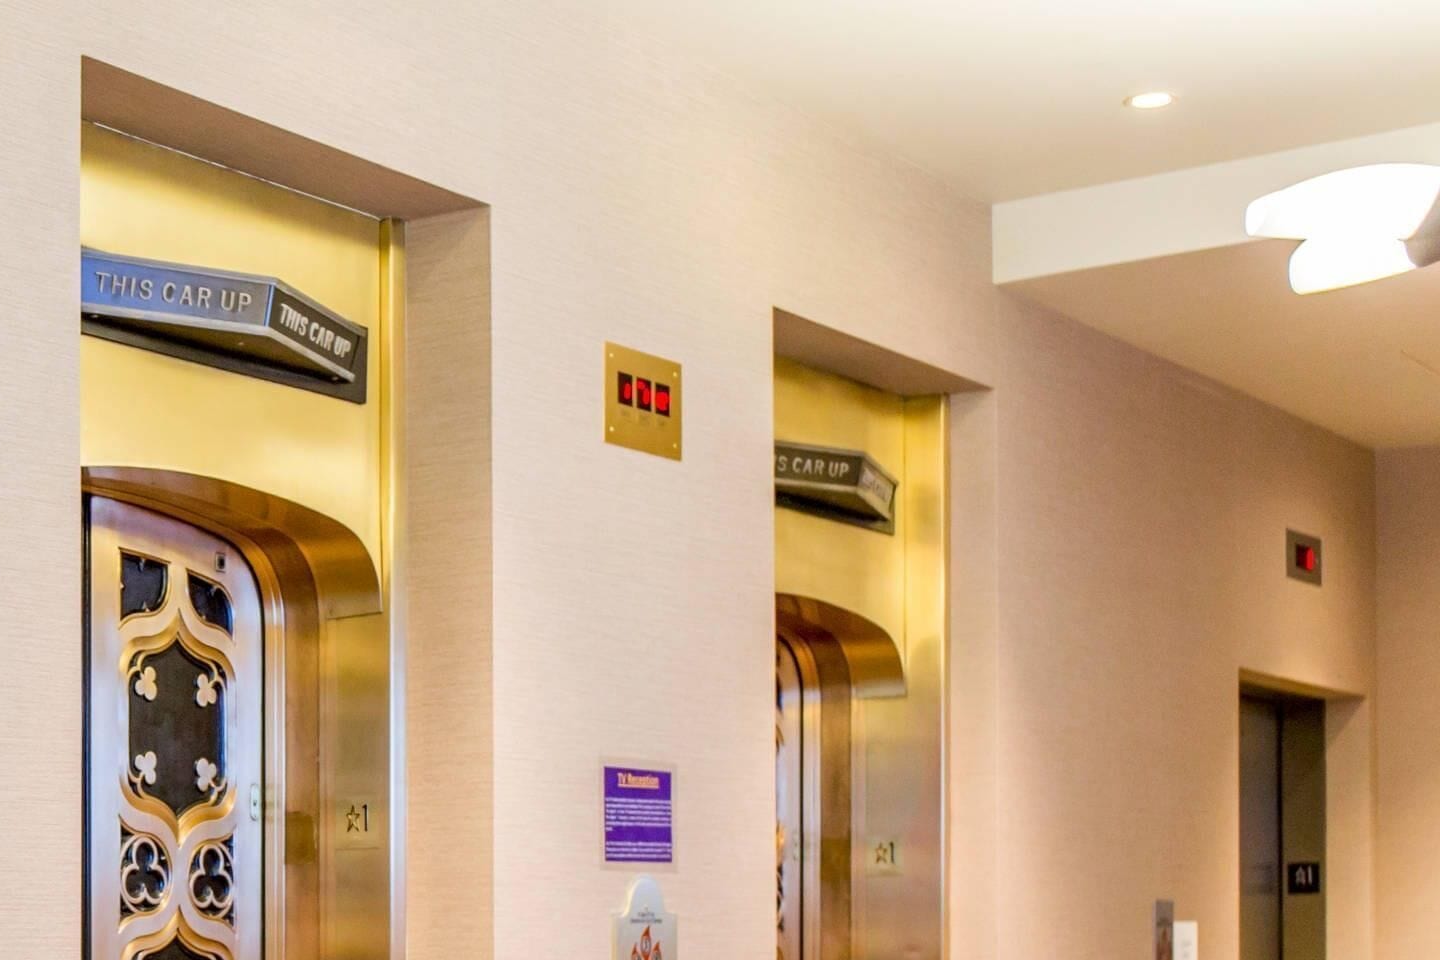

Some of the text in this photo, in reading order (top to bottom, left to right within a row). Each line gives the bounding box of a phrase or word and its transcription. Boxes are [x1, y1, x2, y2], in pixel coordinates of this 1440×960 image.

[95, 271, 252, 313] THIS CAR UP
[280, 303, 352, 358] THIS CAR UP
[792, 456, 825, 476] CAR
[828, 461, 850, 477] UP
